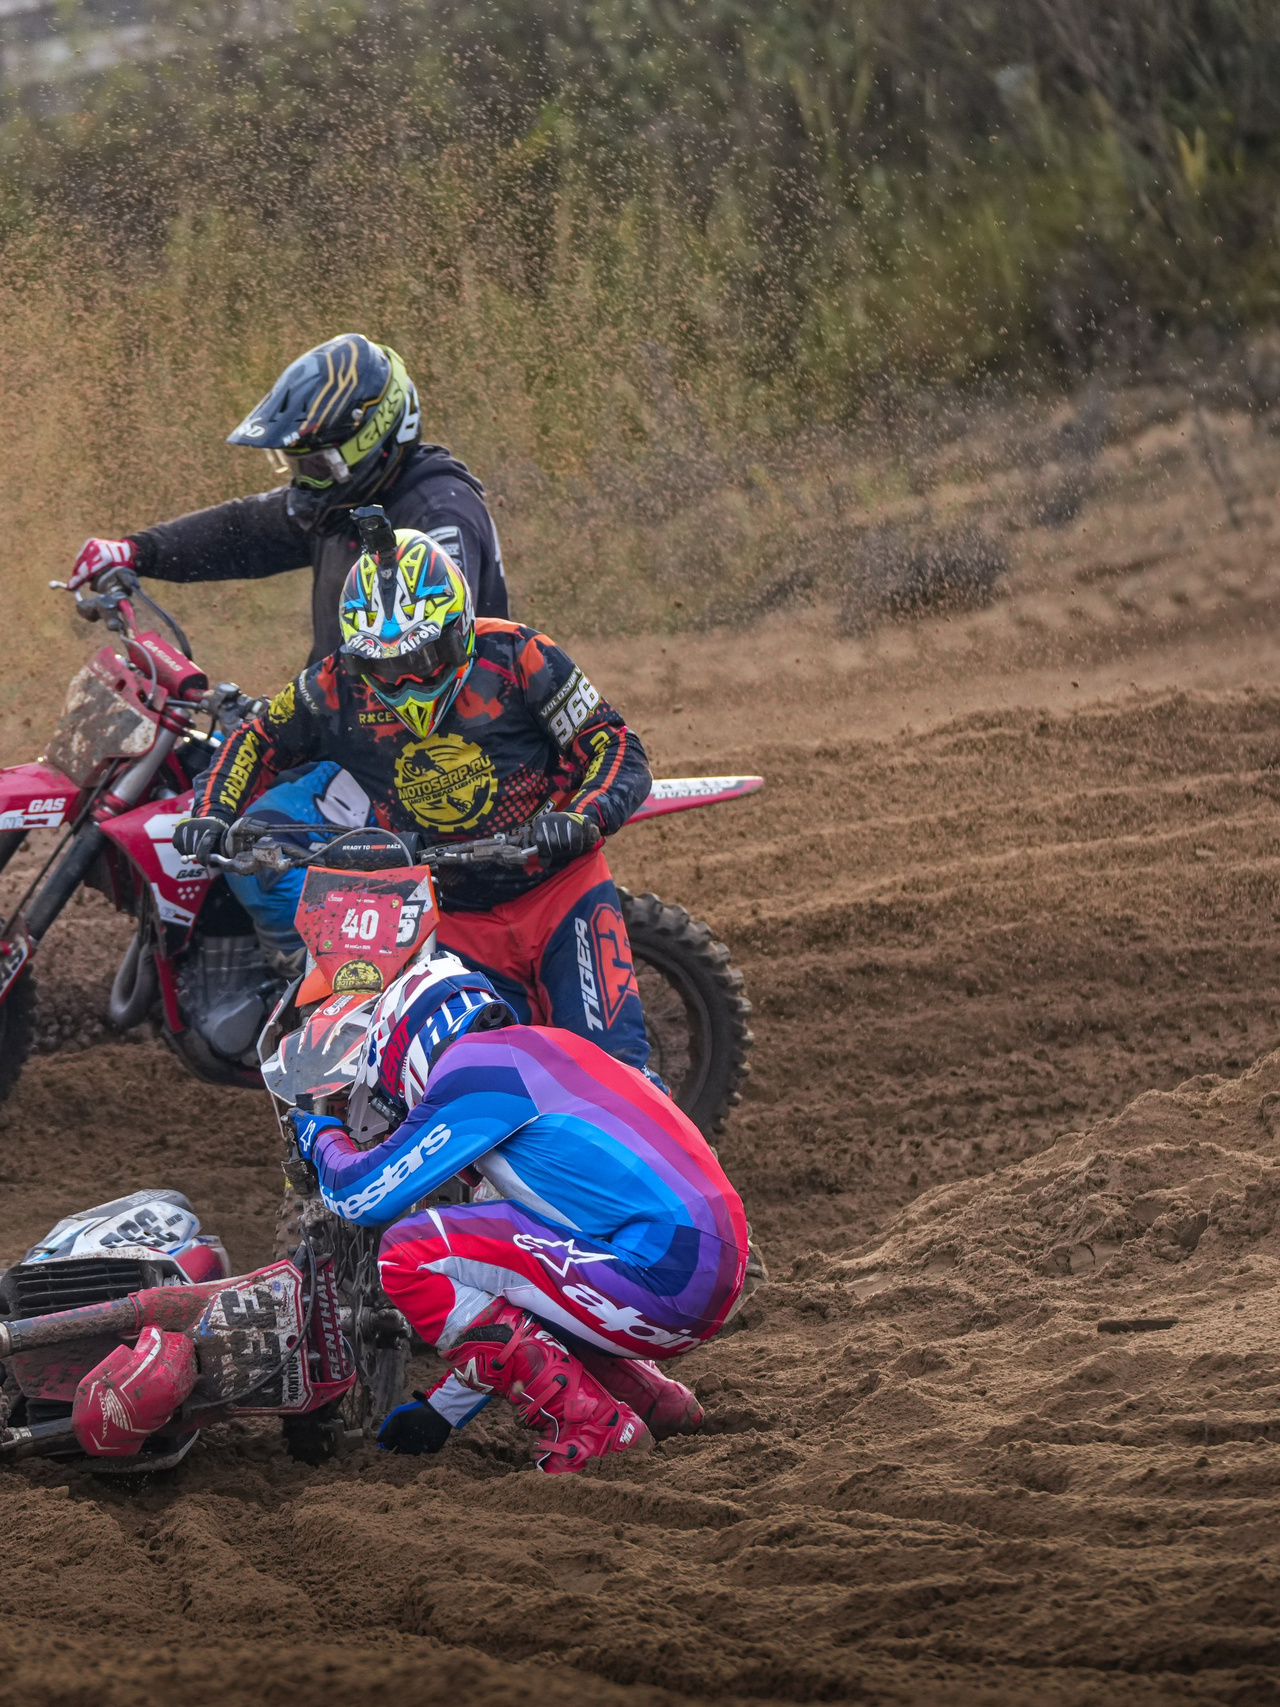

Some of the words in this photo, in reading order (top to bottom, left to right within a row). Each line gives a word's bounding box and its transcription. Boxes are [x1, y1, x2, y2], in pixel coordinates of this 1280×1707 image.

[348, 635, 381, 658] Airoh
[400, 624, 439, 655] Airoh
[550, 676, 599, 746] 966
[400, 755, 492, 800] MOTOSERP.RU
[28, 798, 66, 813] GAS
[176, 868, 205, 879] GAS
[341, 908, 379, 940] 40
[316, 1268, 343, 1381] RENTHAL
[562, 1283, 706, 1352] alpin
[97, 1391, 109, 1441] HONDA
